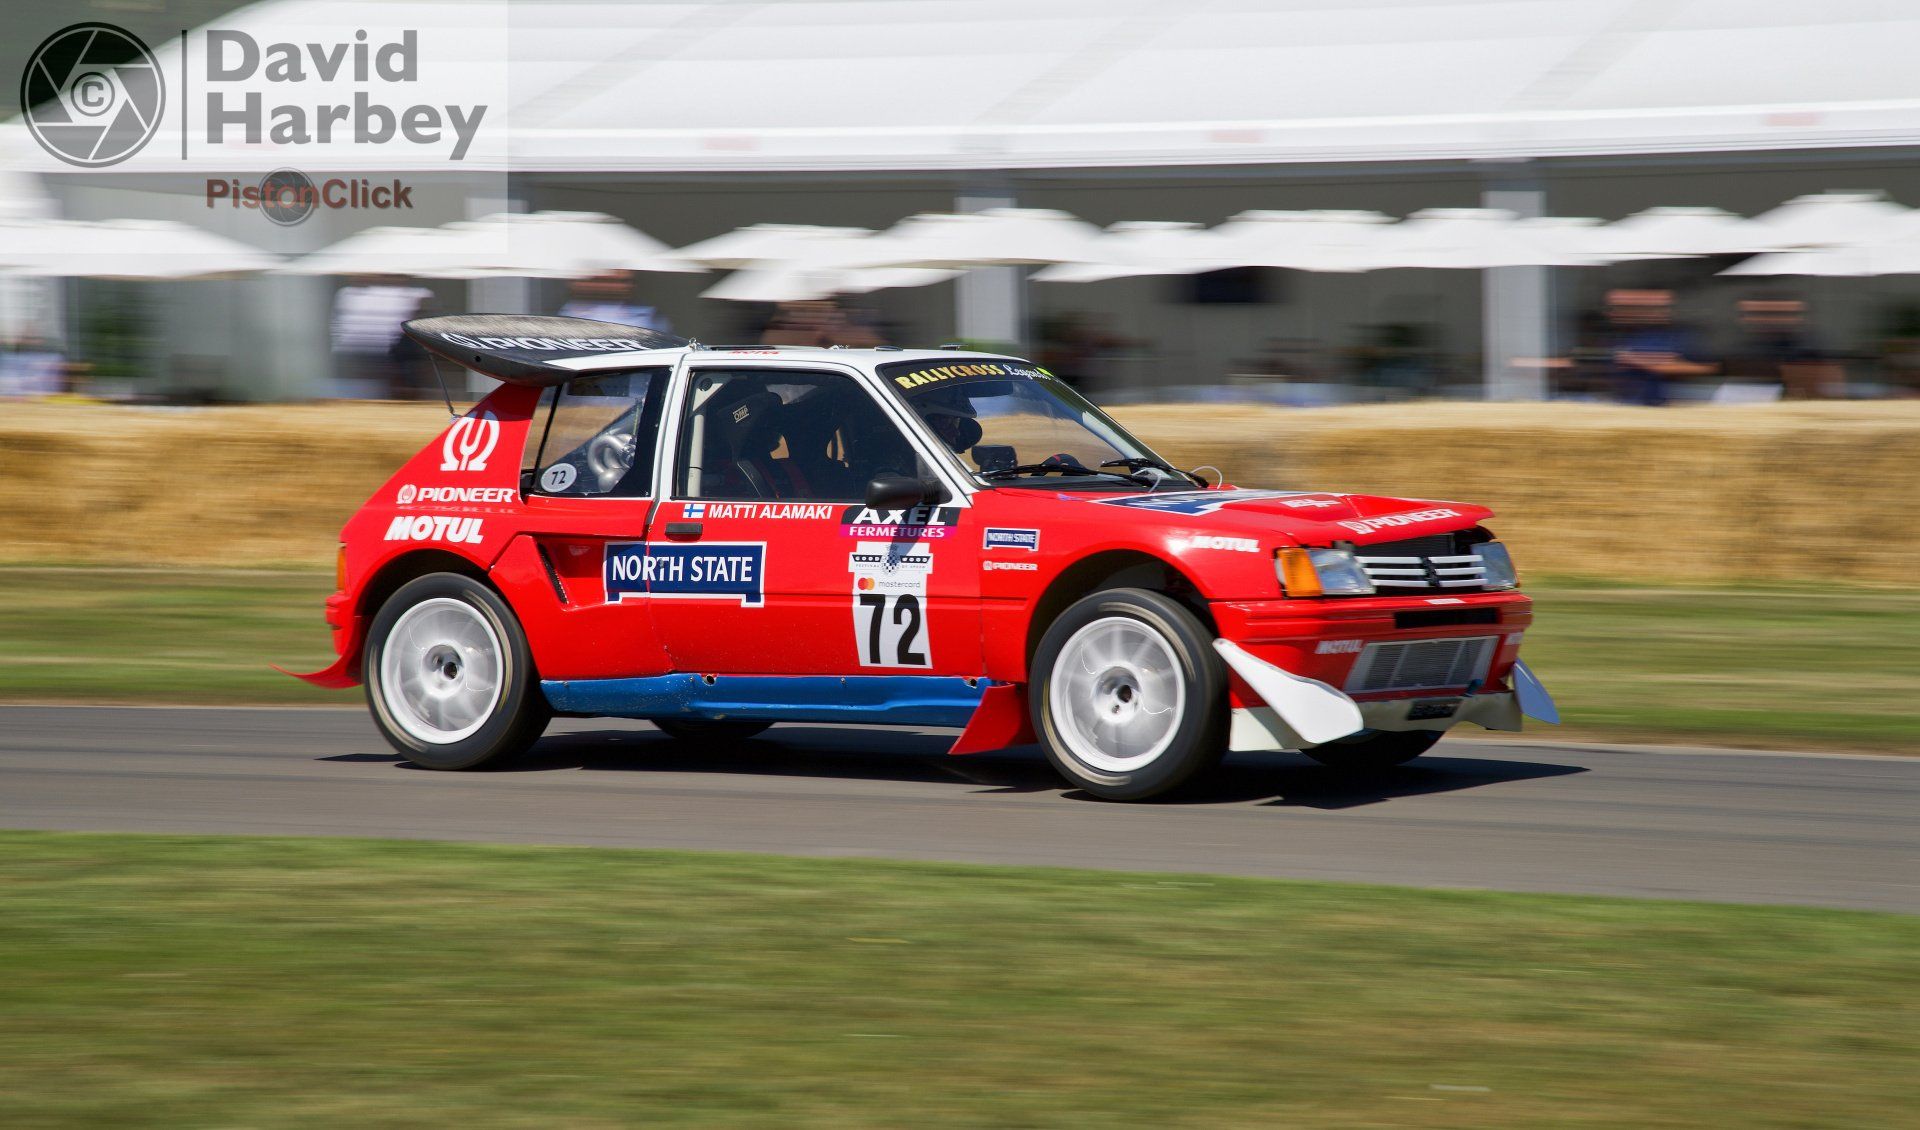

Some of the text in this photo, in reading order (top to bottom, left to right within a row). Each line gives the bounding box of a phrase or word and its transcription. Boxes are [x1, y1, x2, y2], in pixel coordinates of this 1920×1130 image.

[478, 337, 651, 350] PIONEER
[895, 364, 1005, 389] RALLYCROSS
[551, 470, 567, 485] 72
[417, 487, 516, 502] PIONEER
[708, 504, 833, 520] MATTI ALAMAKI
[852, 506, 946, 526] AXEL
[1366, 508, 1462, 529] PIONEER
[384, 516, 483, 544] MOTUL
[849, 526, 945, 538] FERMETURES
[987, 533, 1013, 542] NORTH
[1191, 535, 1260, 552] MOTUL
[612, 555, 753, 582] NORTH STATE
[993, 562, 1038, 570] PIONEER
[858, 594, 926, 666] 72
